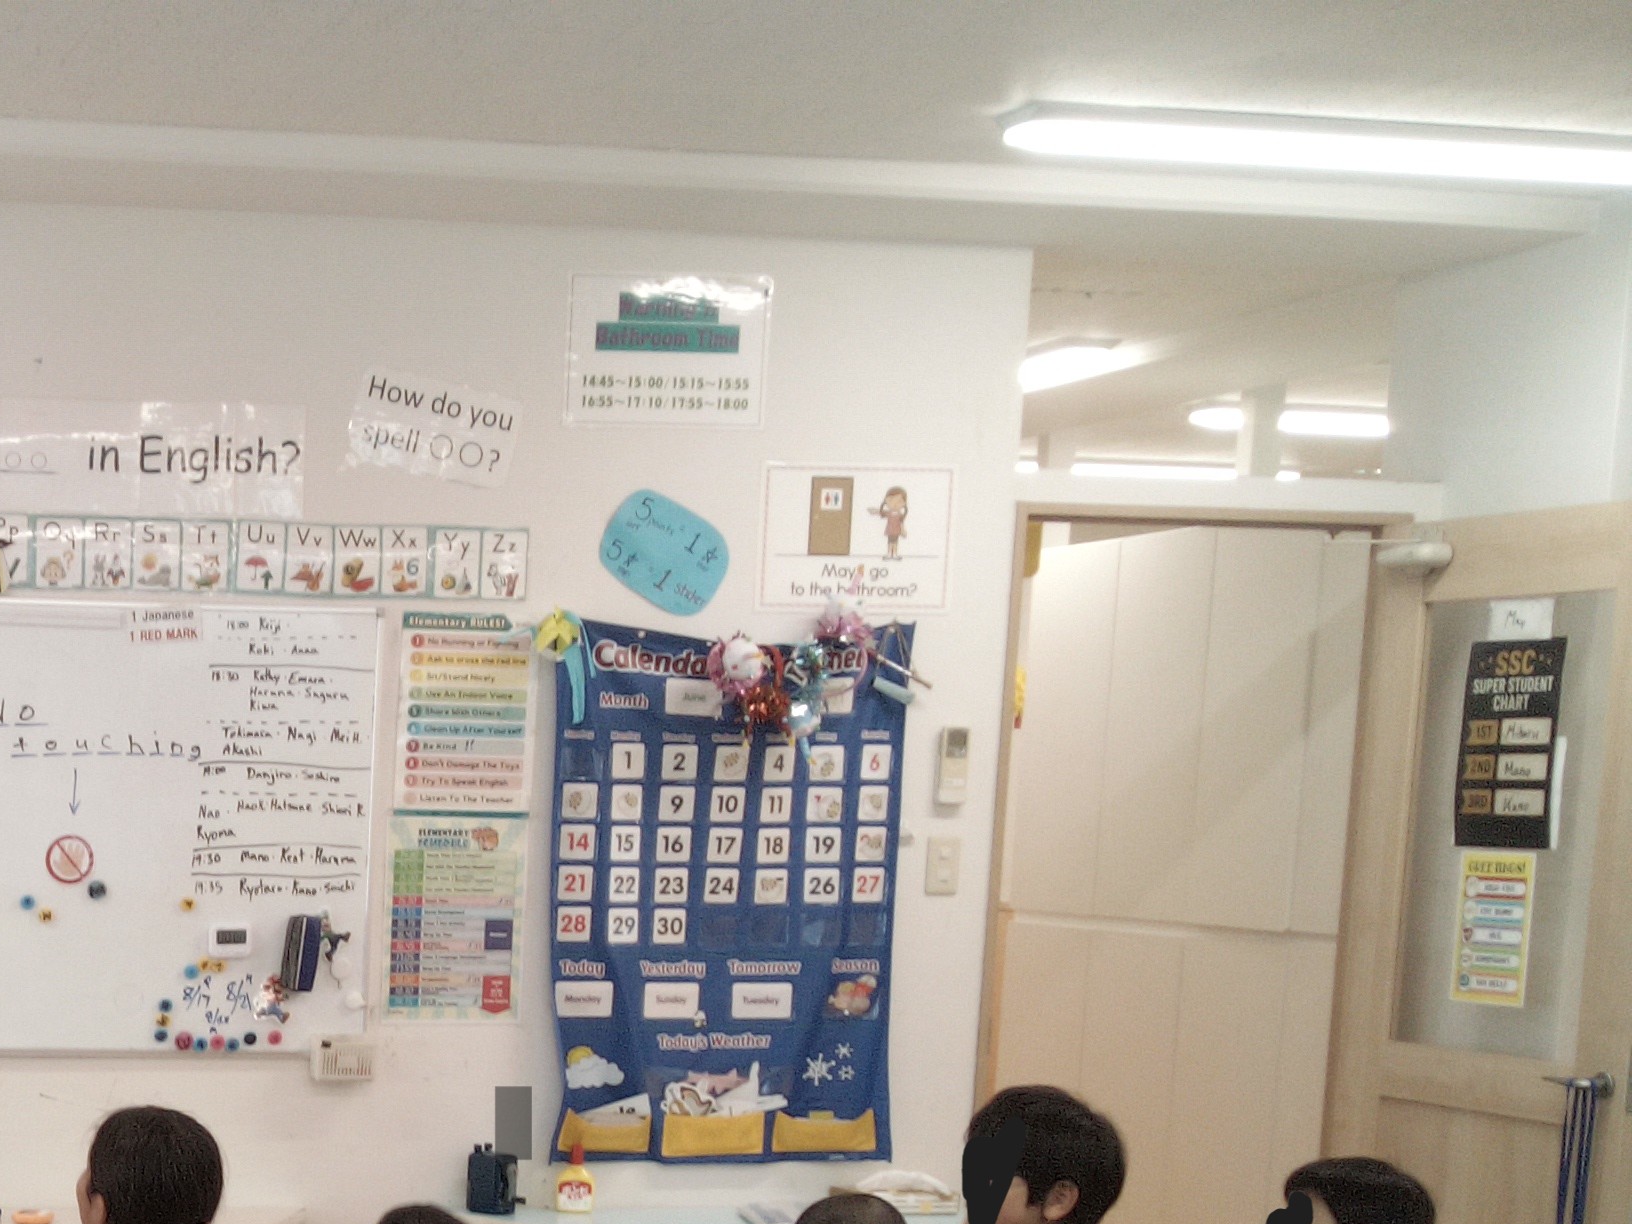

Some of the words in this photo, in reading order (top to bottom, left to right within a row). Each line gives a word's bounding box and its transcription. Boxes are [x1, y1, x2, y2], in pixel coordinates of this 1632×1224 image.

[597, 326, 688, 348] Bathroom
[368, 375, 424, 409] How
[431, 391, 462, 419] do
[469, 404, 514, 432] you
[363, 424, 420, 454] spell
[88, 437, 120, 472] in
[139, 435, 301, 484] English?
[94, 523, 121, 542] Rr
[193, 526, 217, 545] Tt
[444, 534, 470, 560] Yy
[822, 563, 855, 581] May
[869, 566, 888, 582] go
[791, 582, 805, 596] to
[810, 583, 832, 596] the
[837, 583, 917, 597] bthroom?
[142, 610, 194, 622] Japanese
[140, 630, 163, 641] RED
[166, 629, 198, 640] MARK
[594, 640, 708, 677] Calenda
[1495, 650, 1537, 675] SSC
[1473, 678, 1505, 694] SUPER
[1508, 675, 1554, 693] STUDENT
[600, 691, 649, 709] Month
[1493, 694, 1530, 712] CHART
[625, 752, 632, 770] 1
[673, 753, 686, 772] 2
[773, 754, 785, 772] 4
[870, 755, 880, 772] 6
[671, 796, 683, 813] 9
[718, 795, 738, 814] 10
[769, 795, 783, 814] 11
[568, 833, 589, 851] 14
[616, 833, 634, 851] 15
[663, 835, 683, 854] 16
[715, 836, 736, 855] 17
[765, 835, 783, 855] 18
[813, 836, 835, 855] 19
[565, 875, 586, 892] 21
[614, 876, 636, 895] 22
[659, 877, 684, 895] 23
[709, 877, 734, 895] 24
[809, 877, 835, 895] 26
[857, 876, 879, 894] 27
[561, 916, 586, 934] 28
[613, 916, 635, 935] 29
[658, 917, 683, 935] 30
[560, 960, 605, 978] Today
[640, 960, 707, 978] Yesterday
[727, 959, 801, 975] Tomorrow
[710, 1033, 771, 1049] Weather
